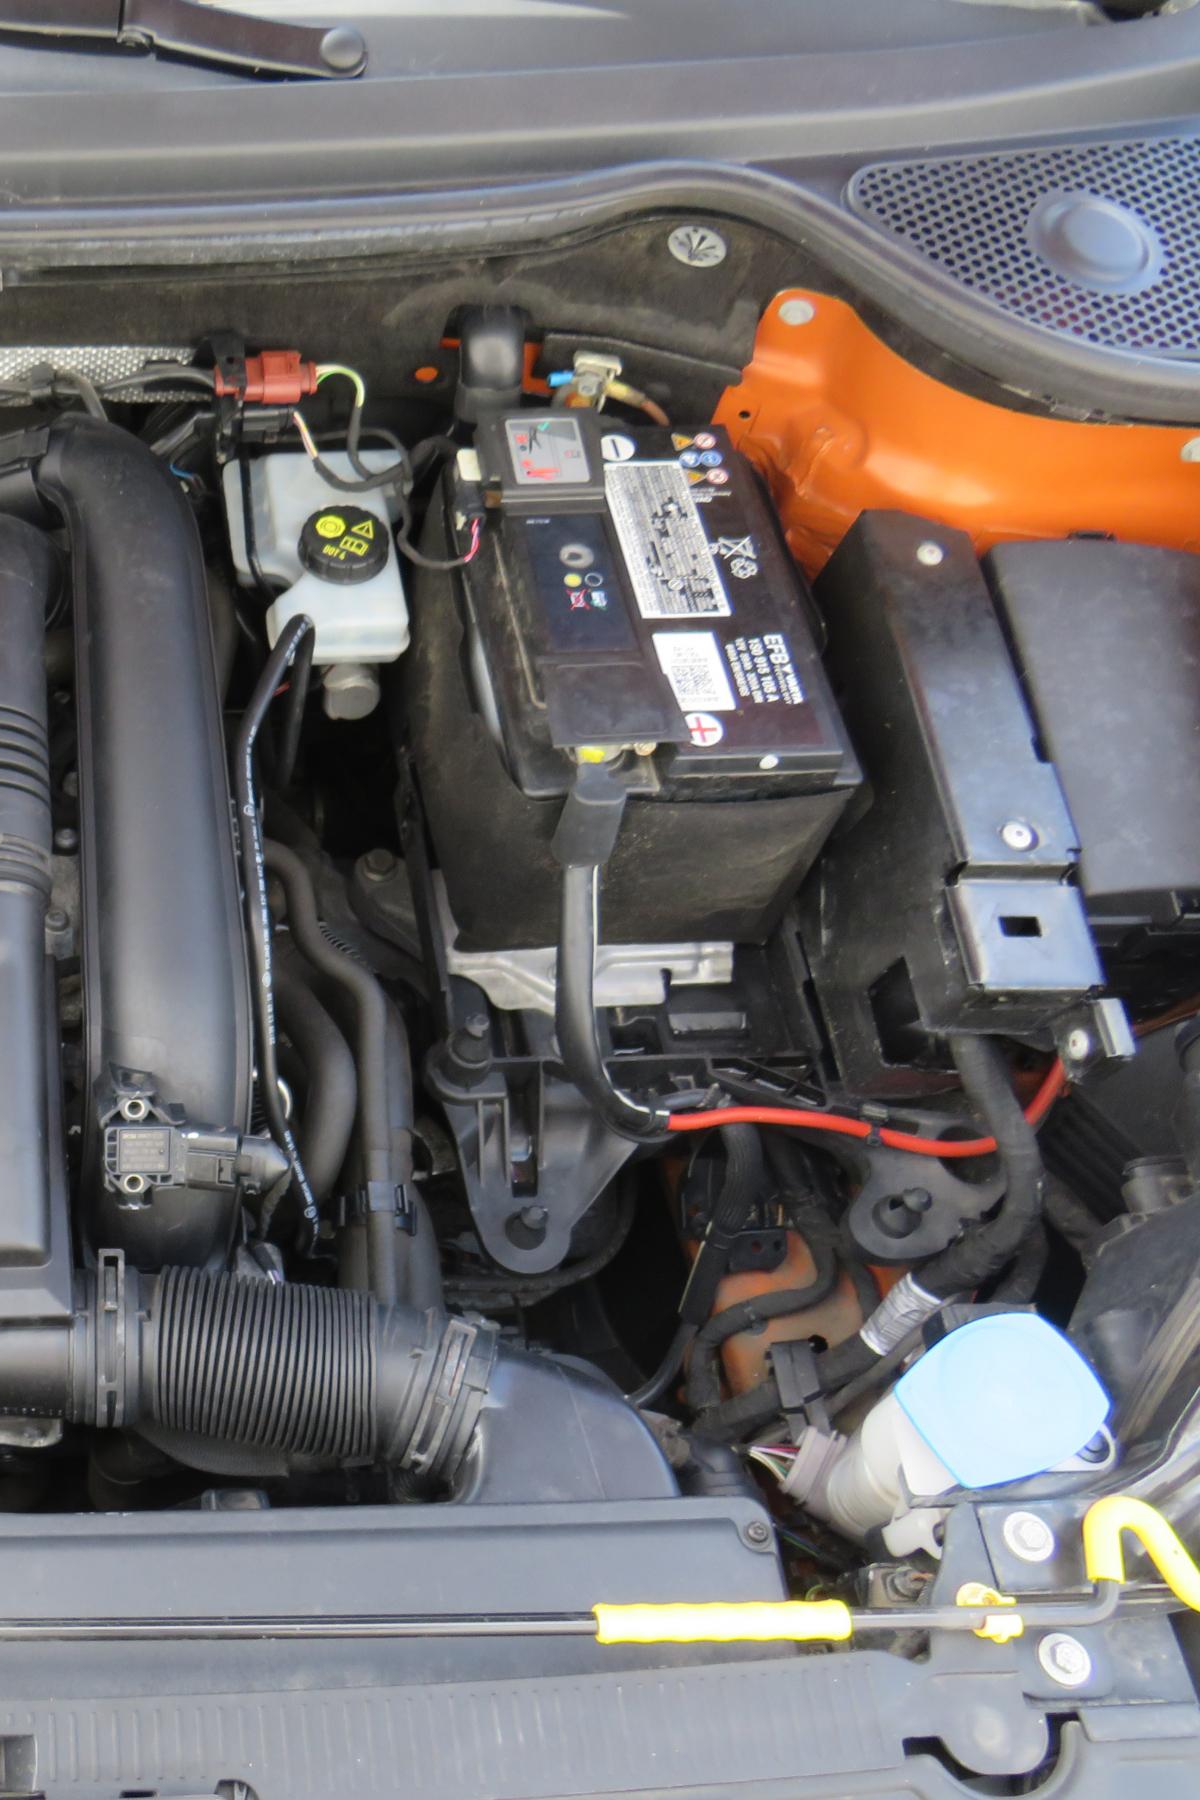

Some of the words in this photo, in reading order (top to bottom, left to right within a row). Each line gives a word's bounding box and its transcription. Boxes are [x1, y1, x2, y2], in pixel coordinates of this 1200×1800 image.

[323, 544, 339, 555] DOT
[762, 634, 790, 664] EFB
[754, 656, 770, 674] 915
[766, 694, 780, 703] A
